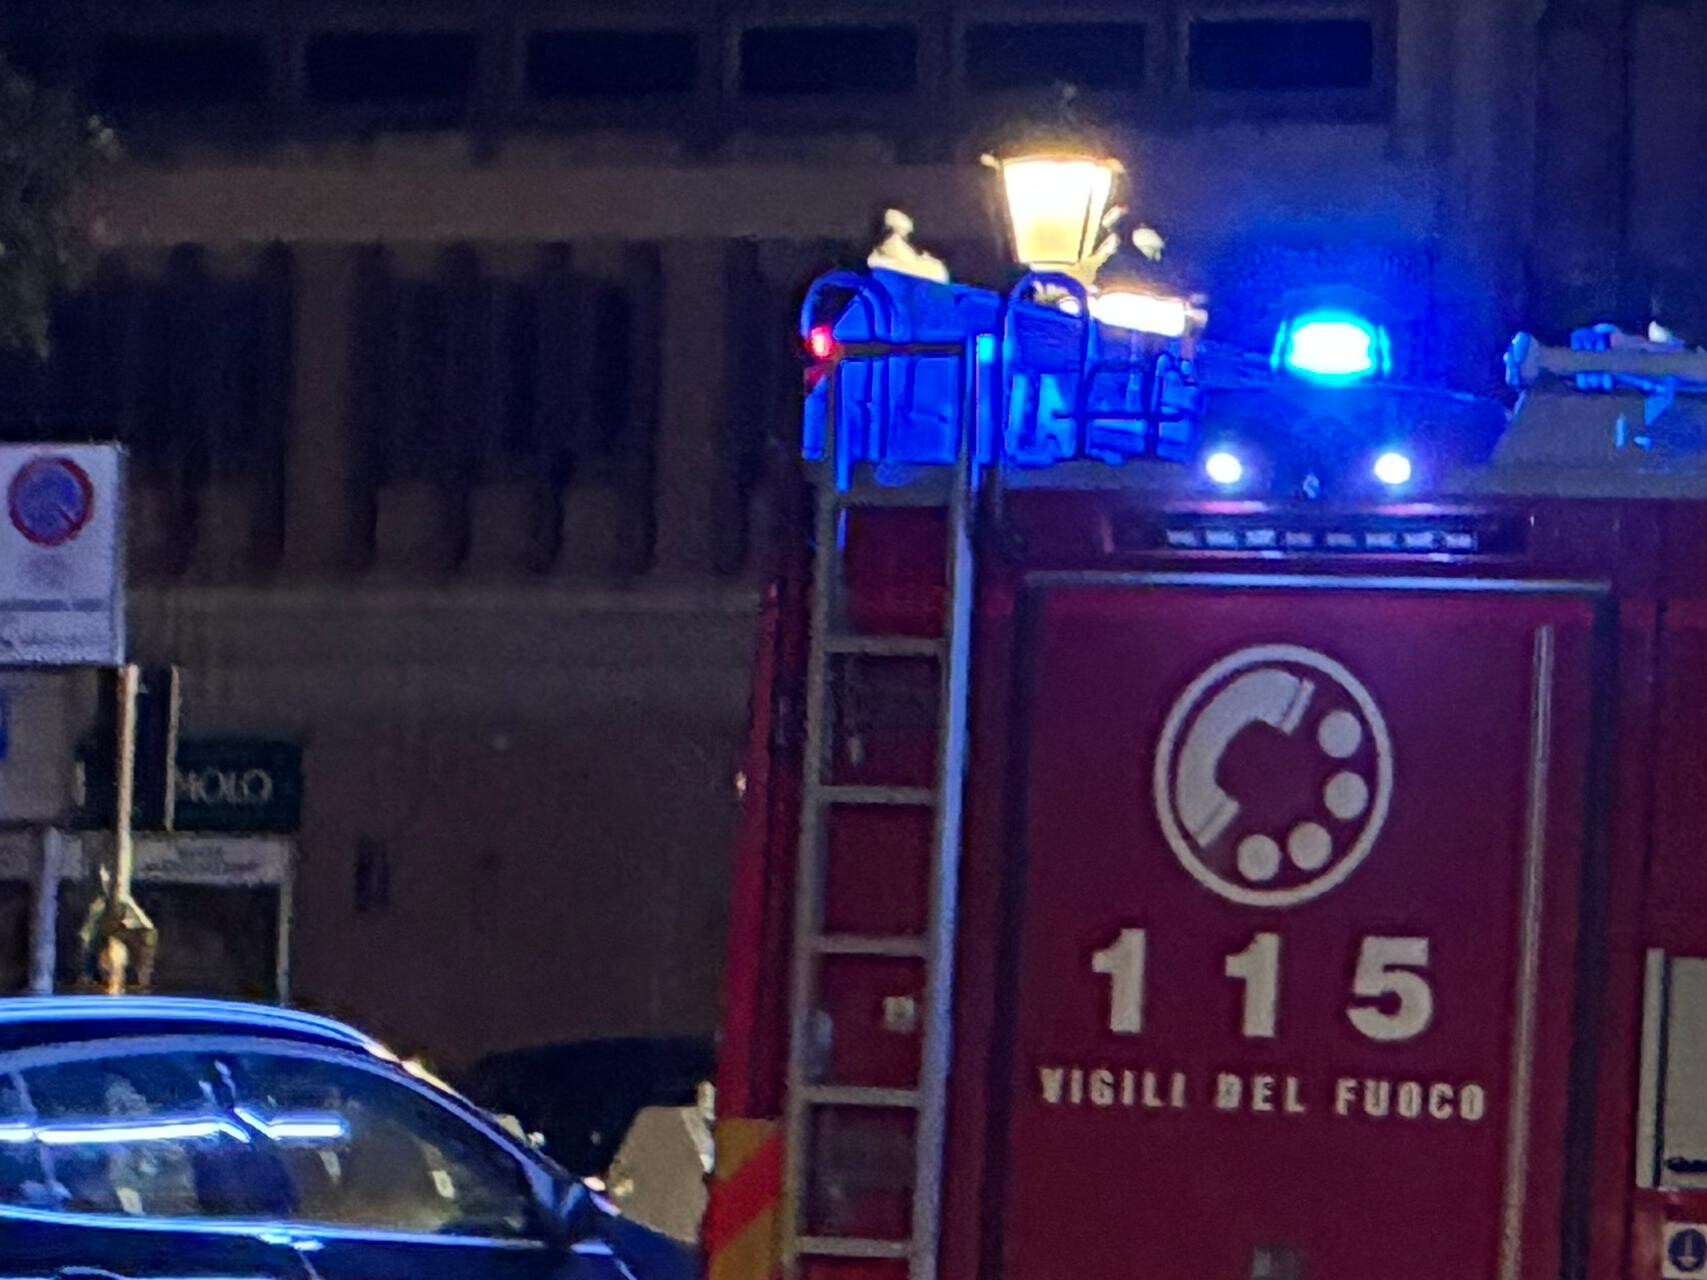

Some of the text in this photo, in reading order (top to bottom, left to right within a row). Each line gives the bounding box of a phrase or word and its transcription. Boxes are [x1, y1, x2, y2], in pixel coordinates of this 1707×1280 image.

[1038, 1066, 1487, 1120] VIGILI DEL FUOCO
